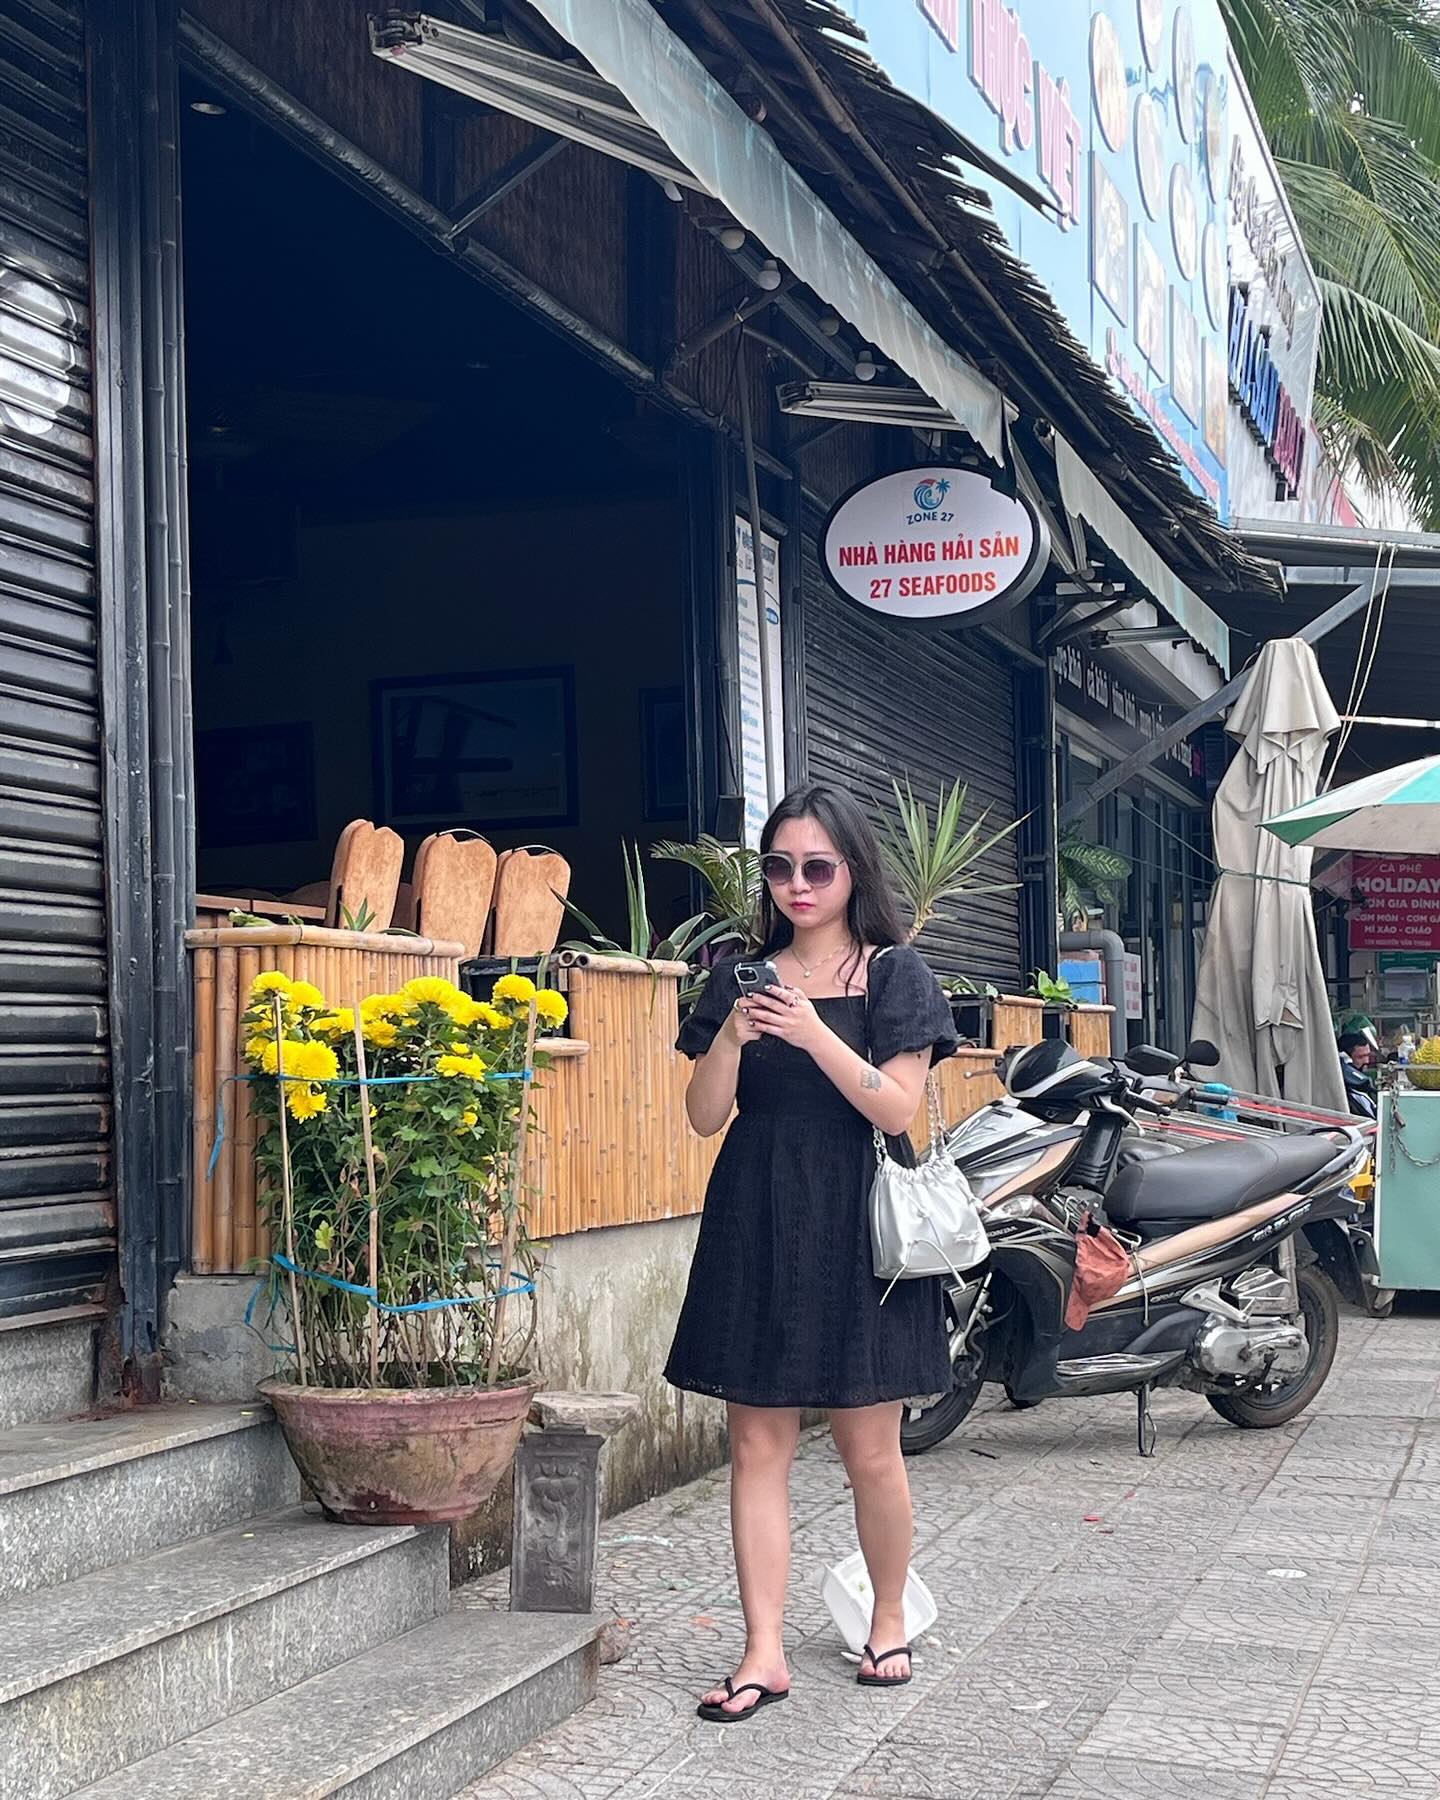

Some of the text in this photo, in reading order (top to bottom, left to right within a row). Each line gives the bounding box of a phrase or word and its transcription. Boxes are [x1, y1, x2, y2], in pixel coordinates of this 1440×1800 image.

[1036, 62, 1081, 231] VIỆT
[906, 511, 954, 525] ZONE 27
[838, 530, 1019, 567] NHÀ HÀNG HẢI SẢN
[870, 571, 996, 598] 27 SEAFOODS
[1356, 876, 1440, 894] HOLIDAY
[1387, 898, 1408, 909] GIA
